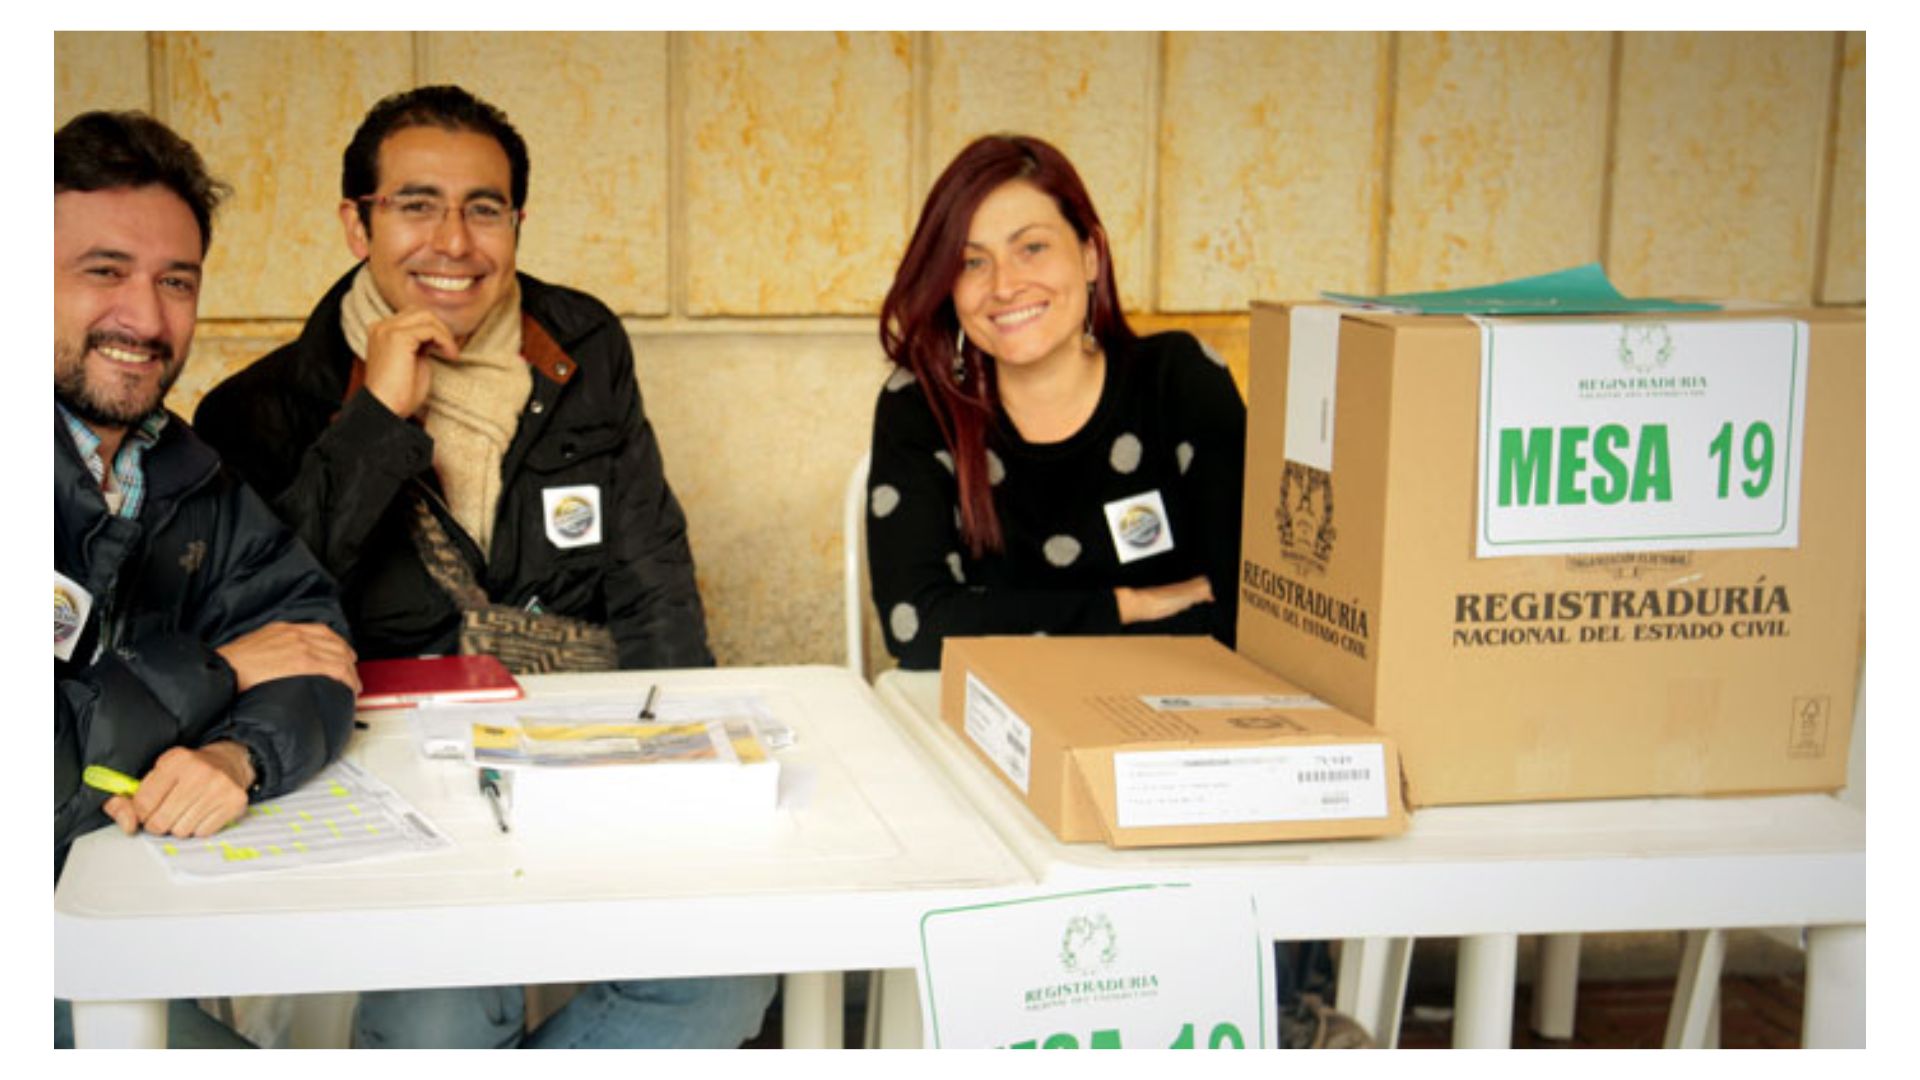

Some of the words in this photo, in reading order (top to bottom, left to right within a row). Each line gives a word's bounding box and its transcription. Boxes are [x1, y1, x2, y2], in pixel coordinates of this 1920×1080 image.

[1498, 424, 1672, 507] MESA
[1709, 421, 1775, 499] 19
[1244, 560, 1368, 638] REGISTRADURÍA
[1455, 575, 1792, 623] REGISTRADURÍA
[1453, 626, 1571, 648] NACIONAL
[1579, 624, 1625, 642] DEL
[1633, 621, 1724, 641] ESTADO
[1730, 619, 1790, 638] CIVIL
